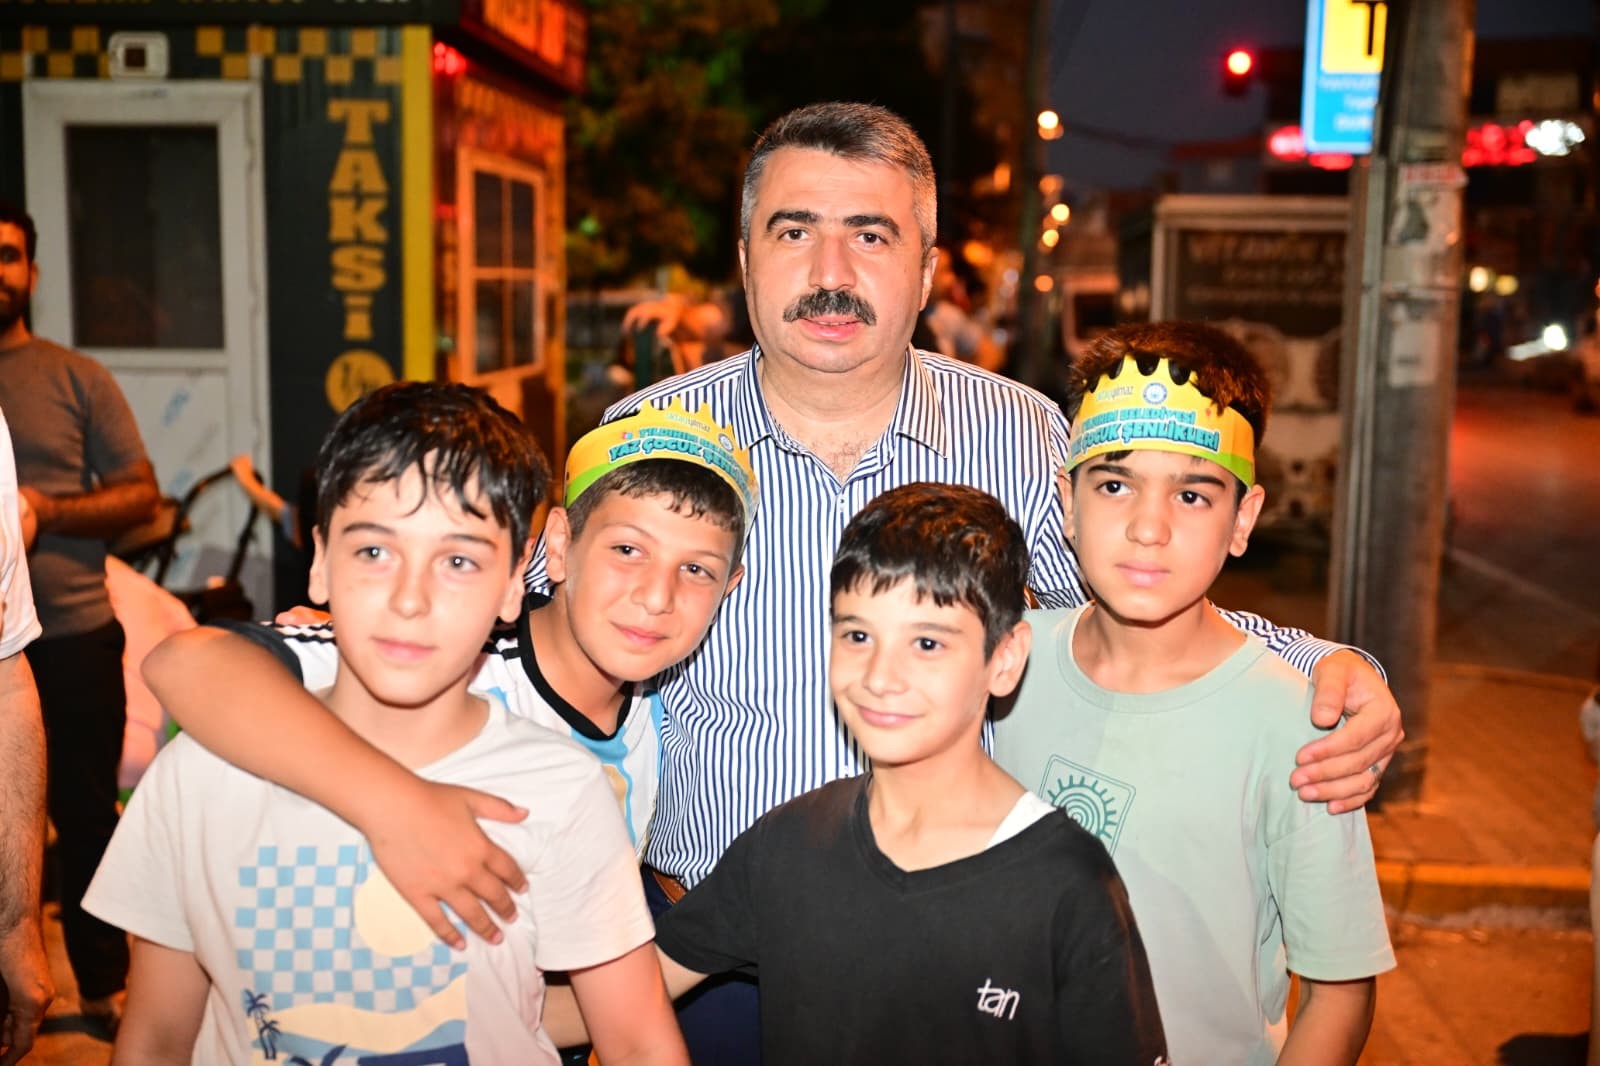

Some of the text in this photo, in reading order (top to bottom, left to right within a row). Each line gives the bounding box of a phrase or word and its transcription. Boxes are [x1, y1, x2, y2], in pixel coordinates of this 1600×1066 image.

[609, 440, 641, 462] YAZ
[642, 438, 704, 457] ÇOCUK
[1121, 420, 1220, 452] ŞENLİKLERİ
[976, 977, 1021, 1021] tan
